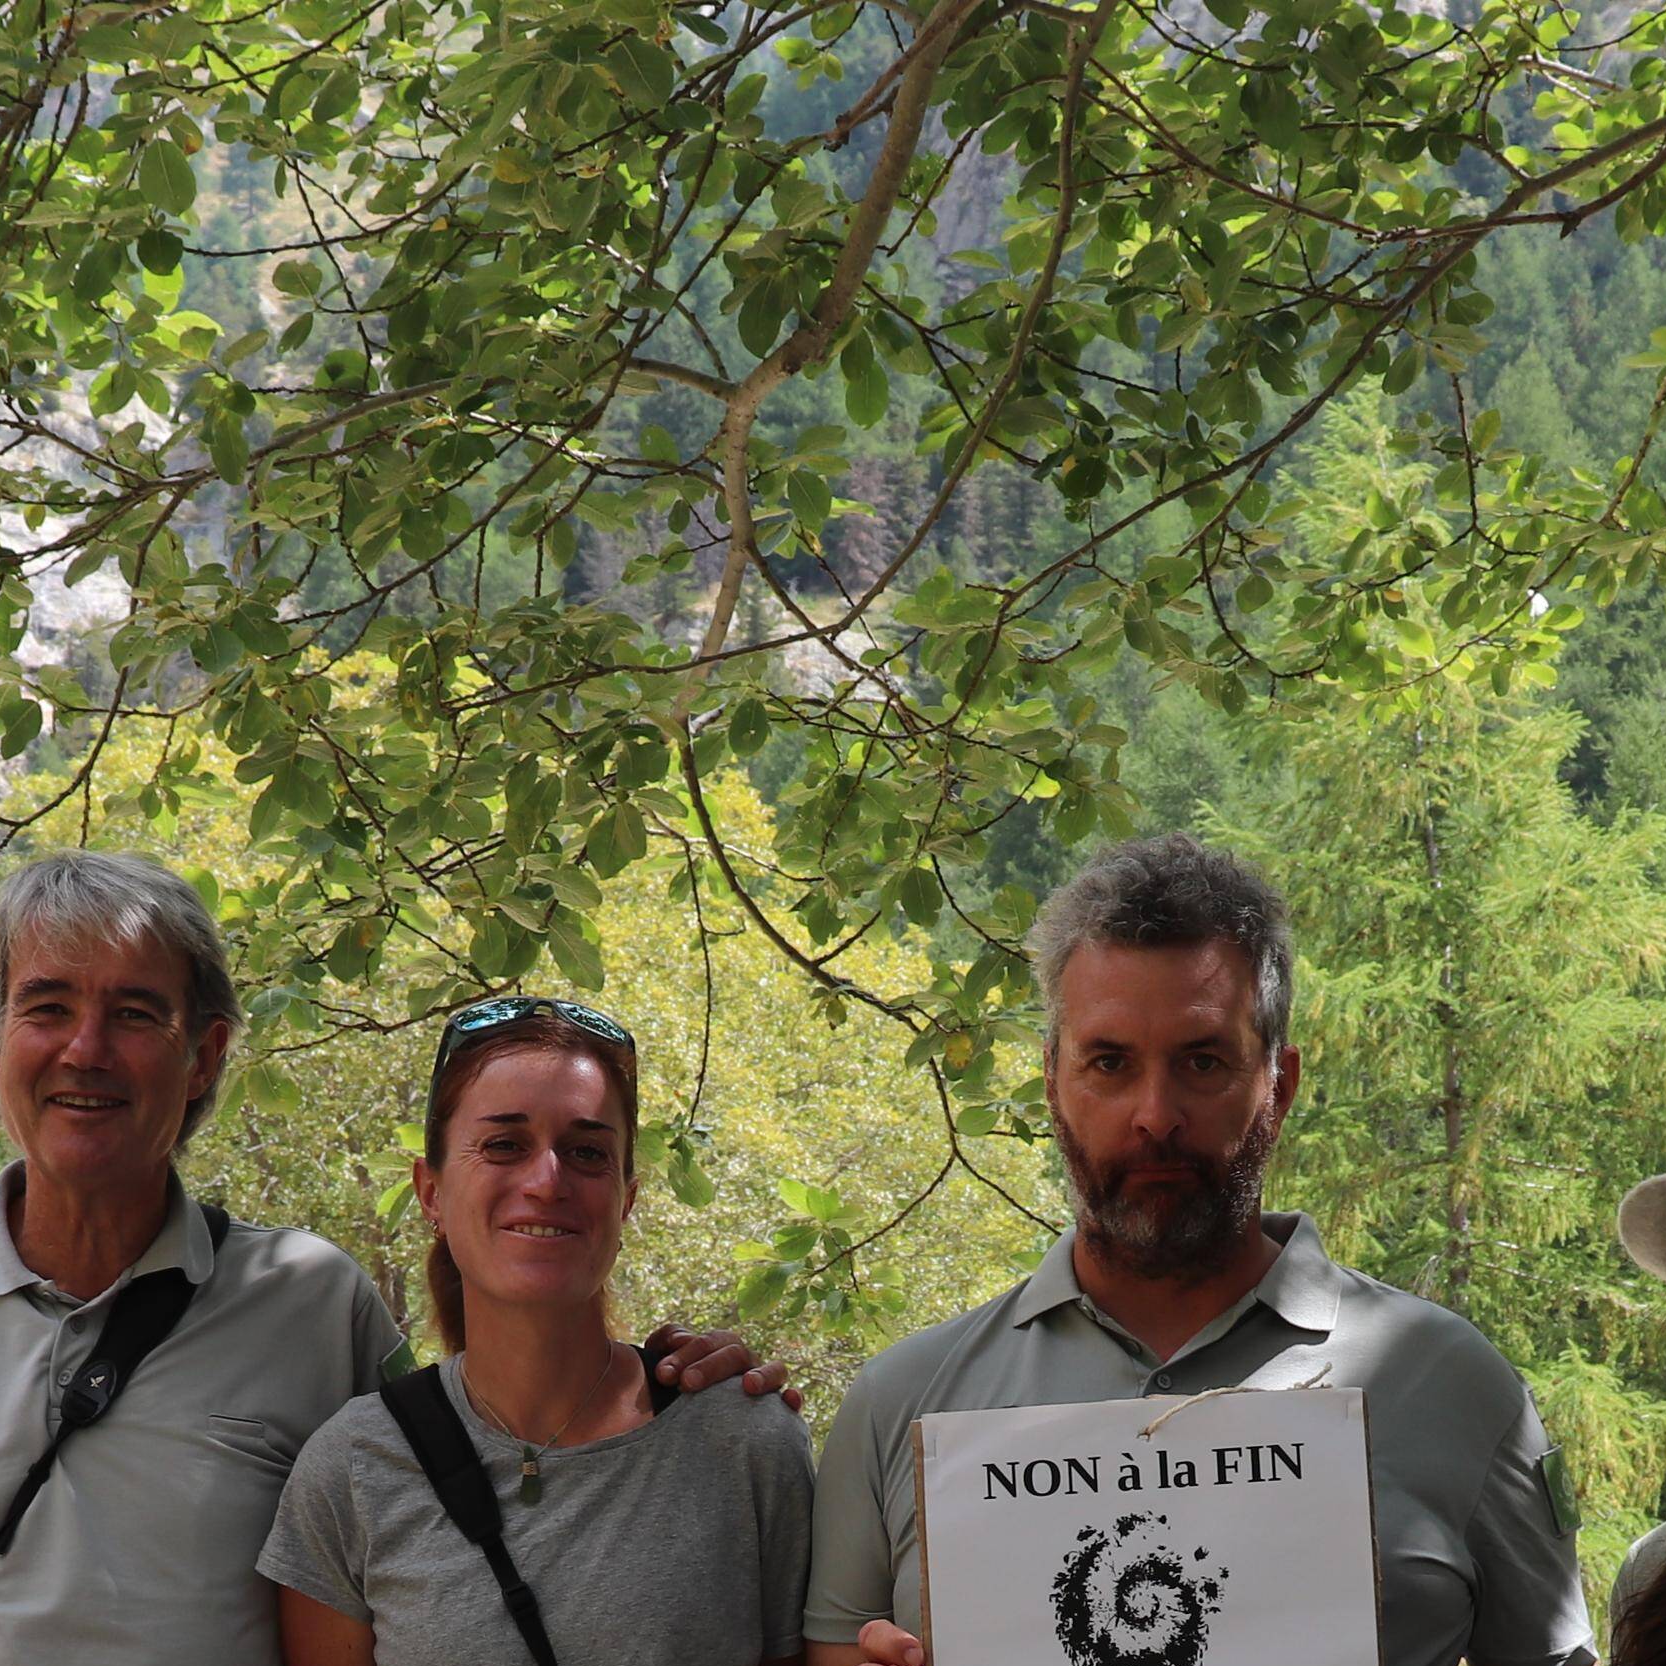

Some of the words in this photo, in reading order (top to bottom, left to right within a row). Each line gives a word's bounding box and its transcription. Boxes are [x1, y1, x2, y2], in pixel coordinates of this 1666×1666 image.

[982, 1457, 1101, 1500] NON
[1118, 1453, 1144, 1492] à
[1157, 1451, 1199, 1489] la
[1212, 1442, 1305, 1486] FIN
